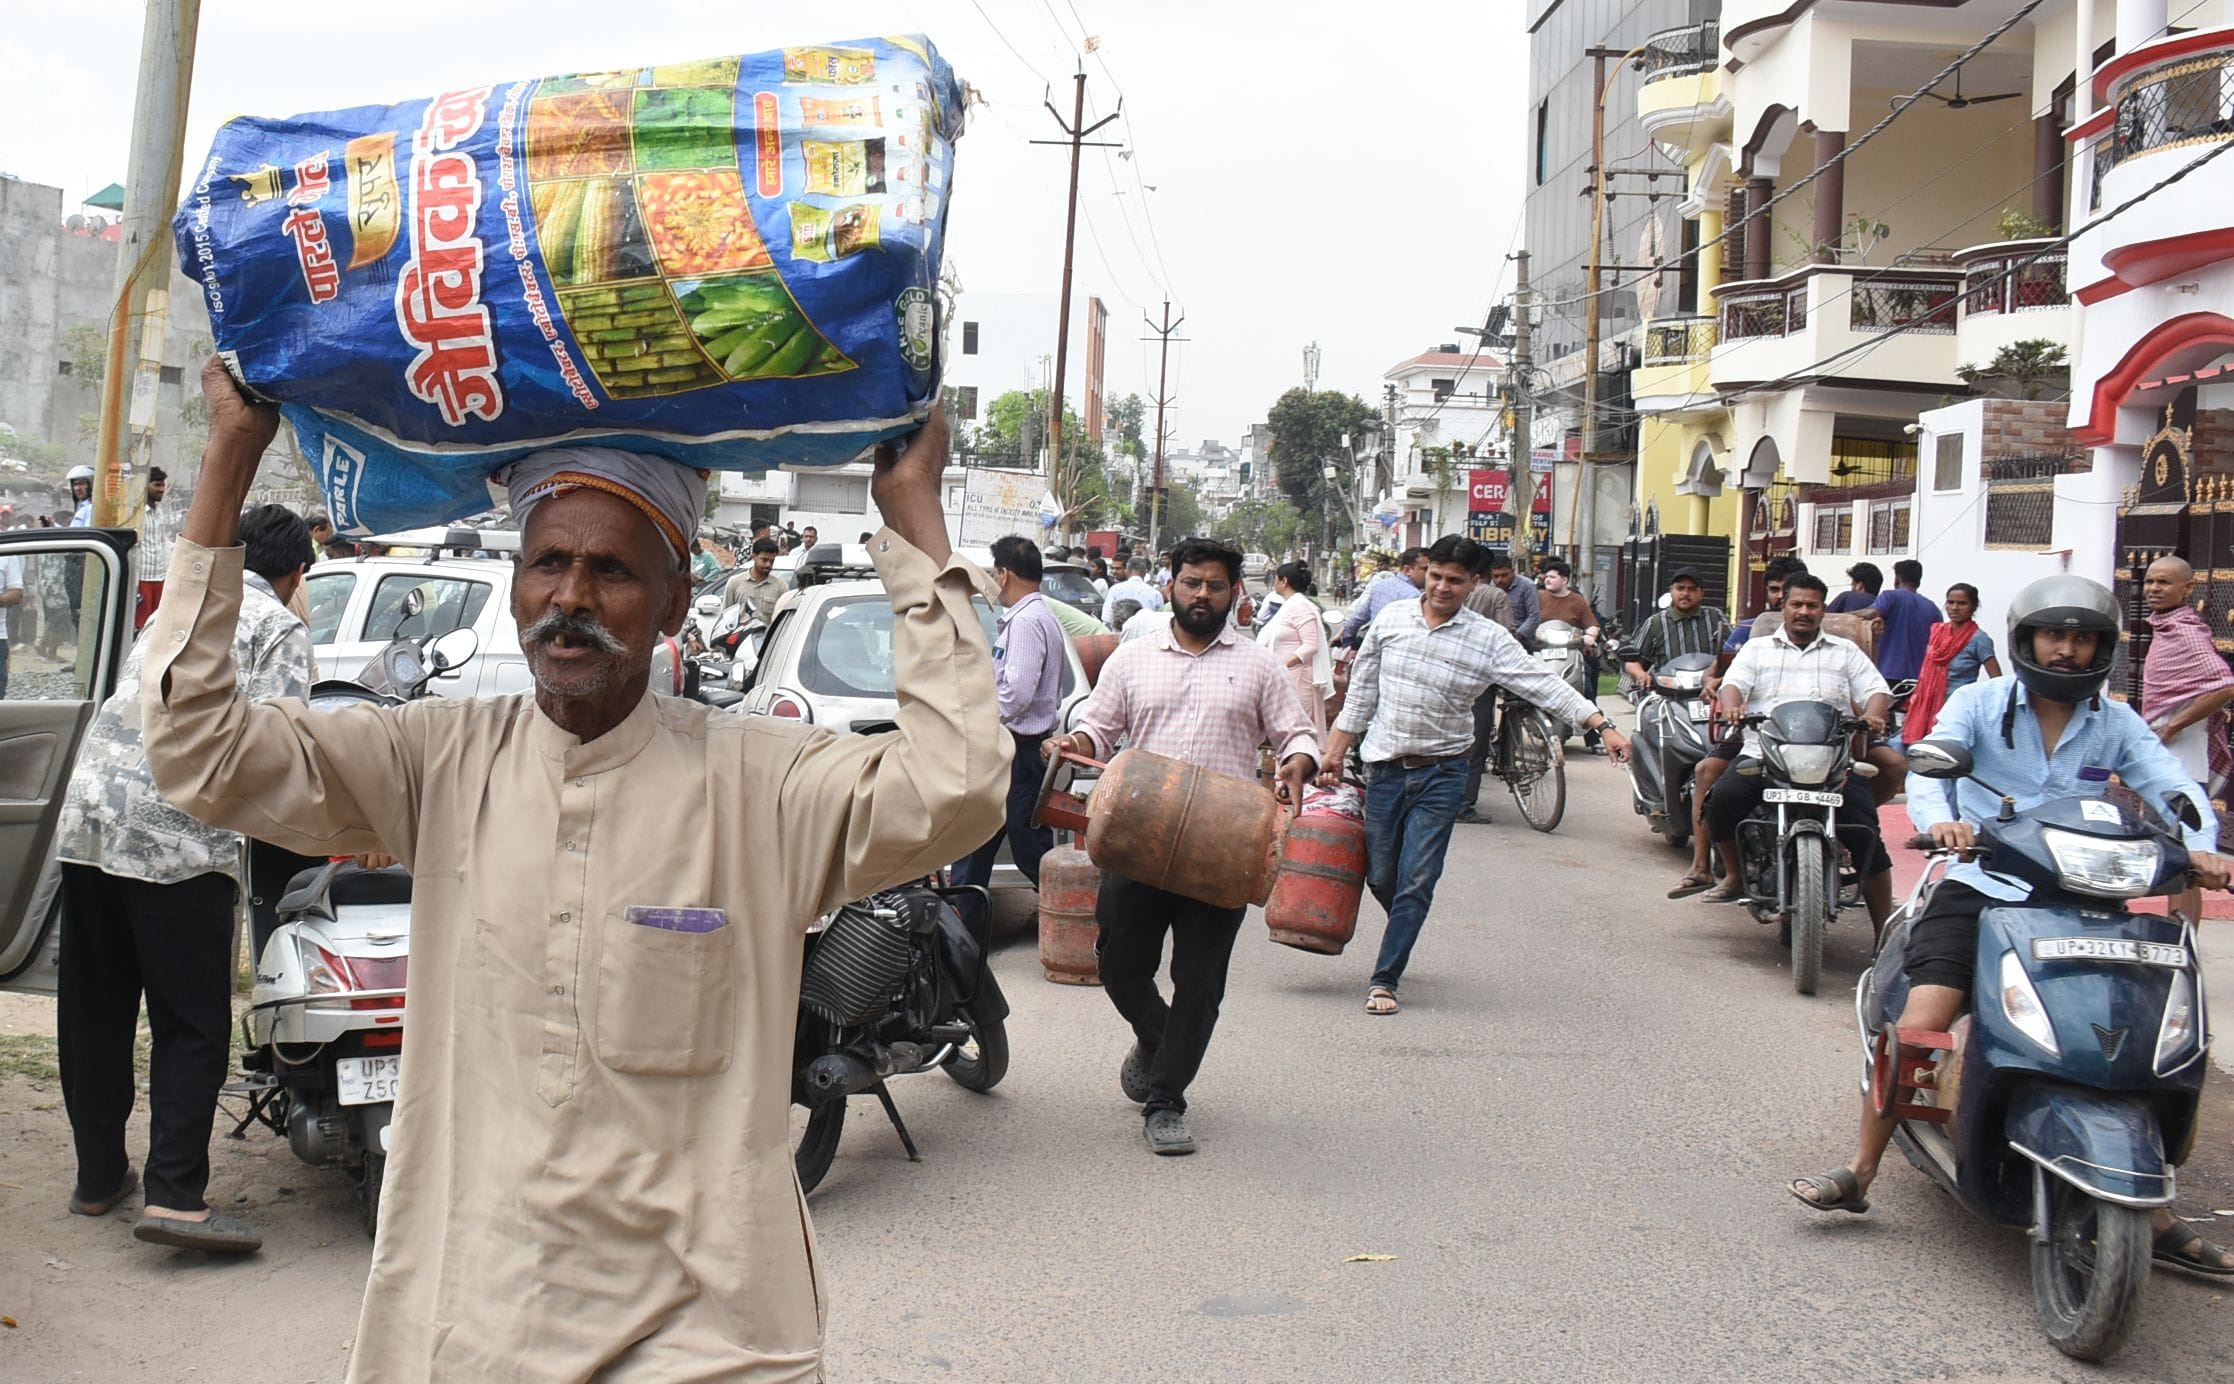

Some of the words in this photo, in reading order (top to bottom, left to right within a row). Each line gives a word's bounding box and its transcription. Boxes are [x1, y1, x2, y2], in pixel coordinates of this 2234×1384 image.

[195, 155, 222, 194] Company
[761, 159, 777, 186] हमारे
[357, 154, 391, 232] सुपर
[283, 209, 338, 302] पारले
[209, 292, 224, 313] ISO
[399, 155, 500, 425] जैविक
[333, 455, 350, 527] PARLE
[966, 493, 983, 504] ICU
[1470, 527, 1548, 542] LIBRY
